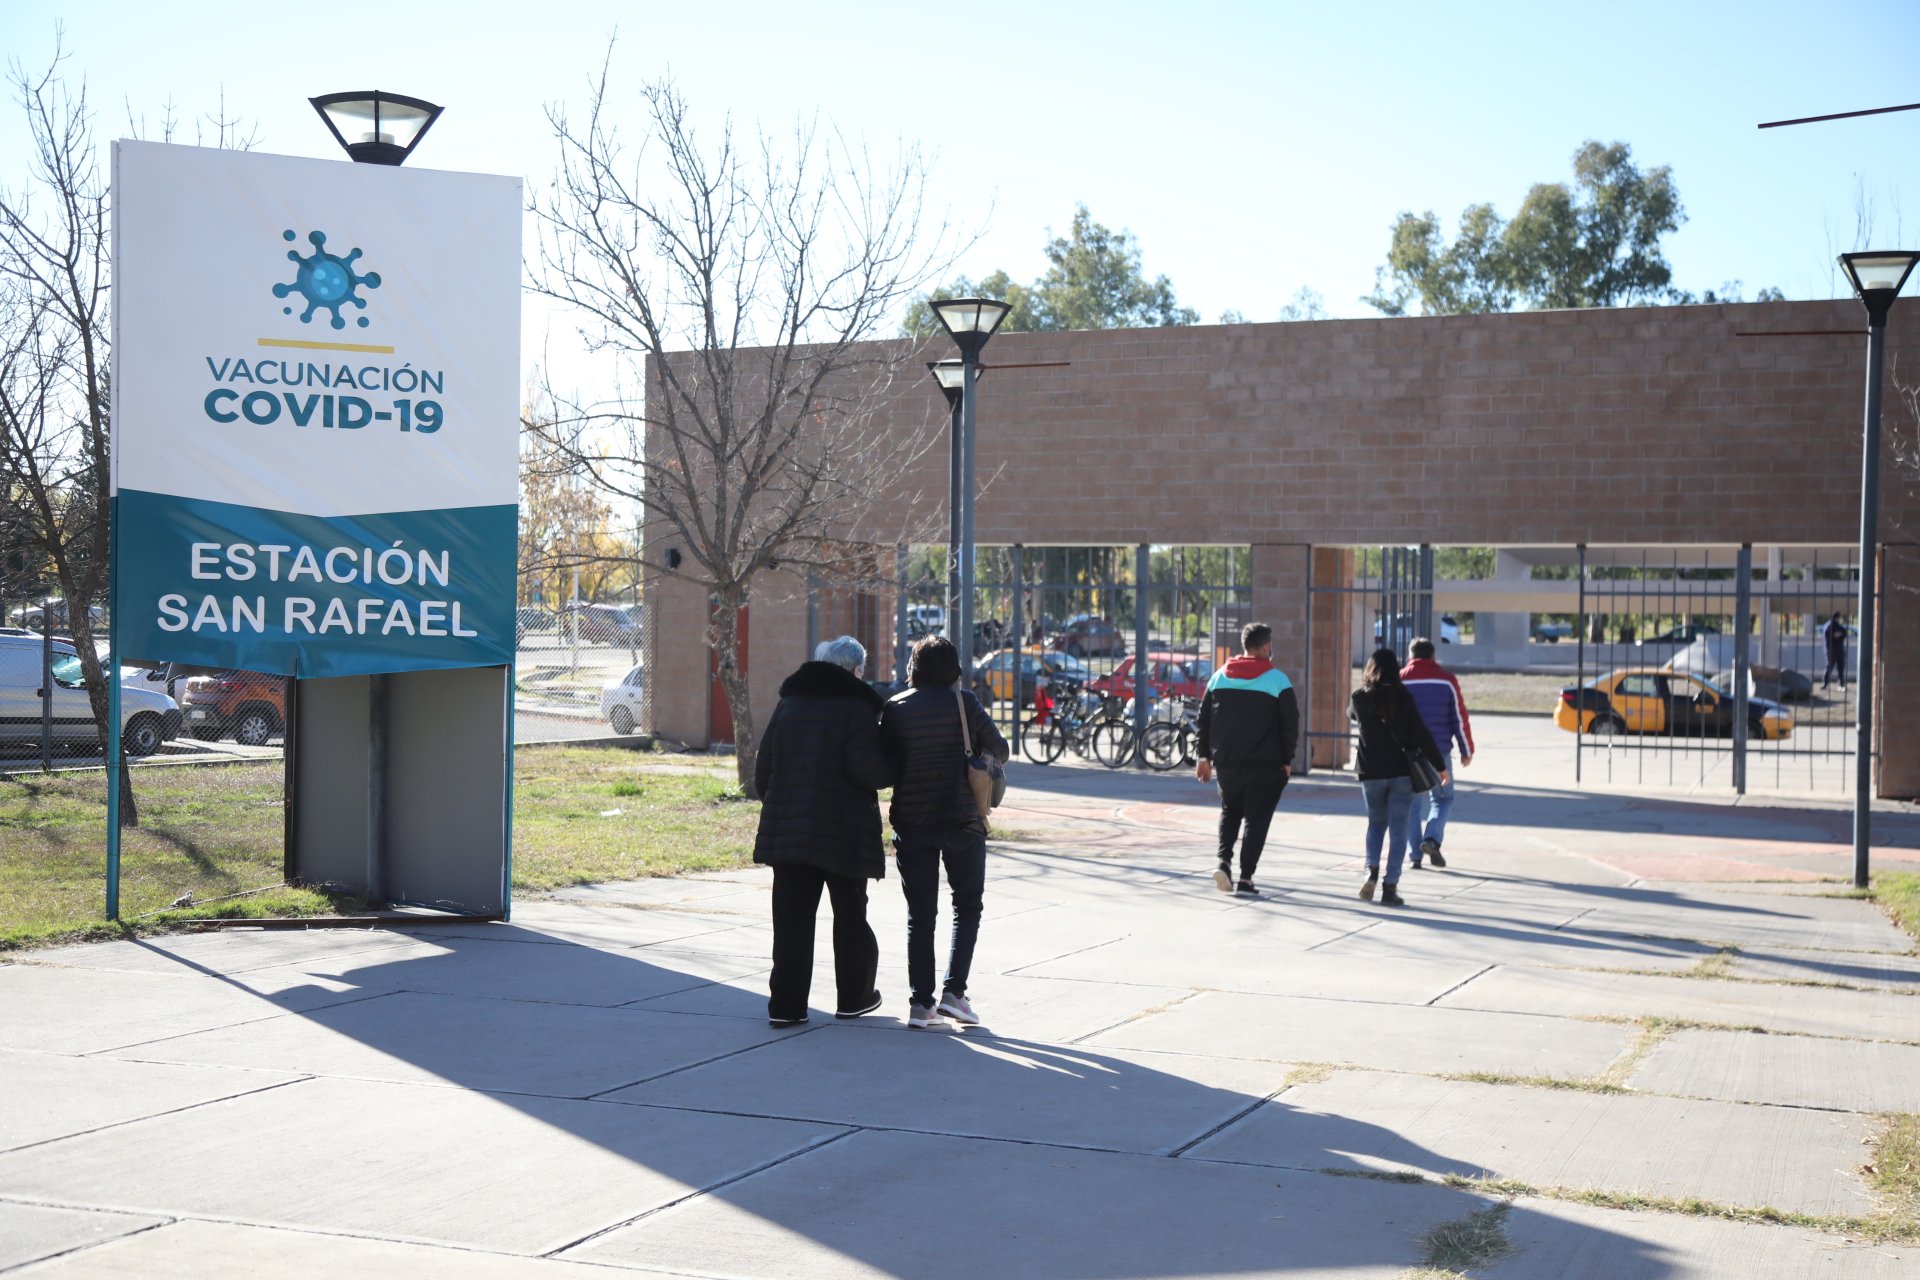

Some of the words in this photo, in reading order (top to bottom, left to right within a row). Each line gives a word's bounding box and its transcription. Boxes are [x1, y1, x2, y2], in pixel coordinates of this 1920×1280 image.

[206, 356, 444, 395] VACUNACIÓN
[204, 388, 444, 434] COVID-19
[191, 540, 449, 587] ESTACIÓN
[157, 594, 265, 633] SAN
[285, 597, 478, 637] RAFAEL
